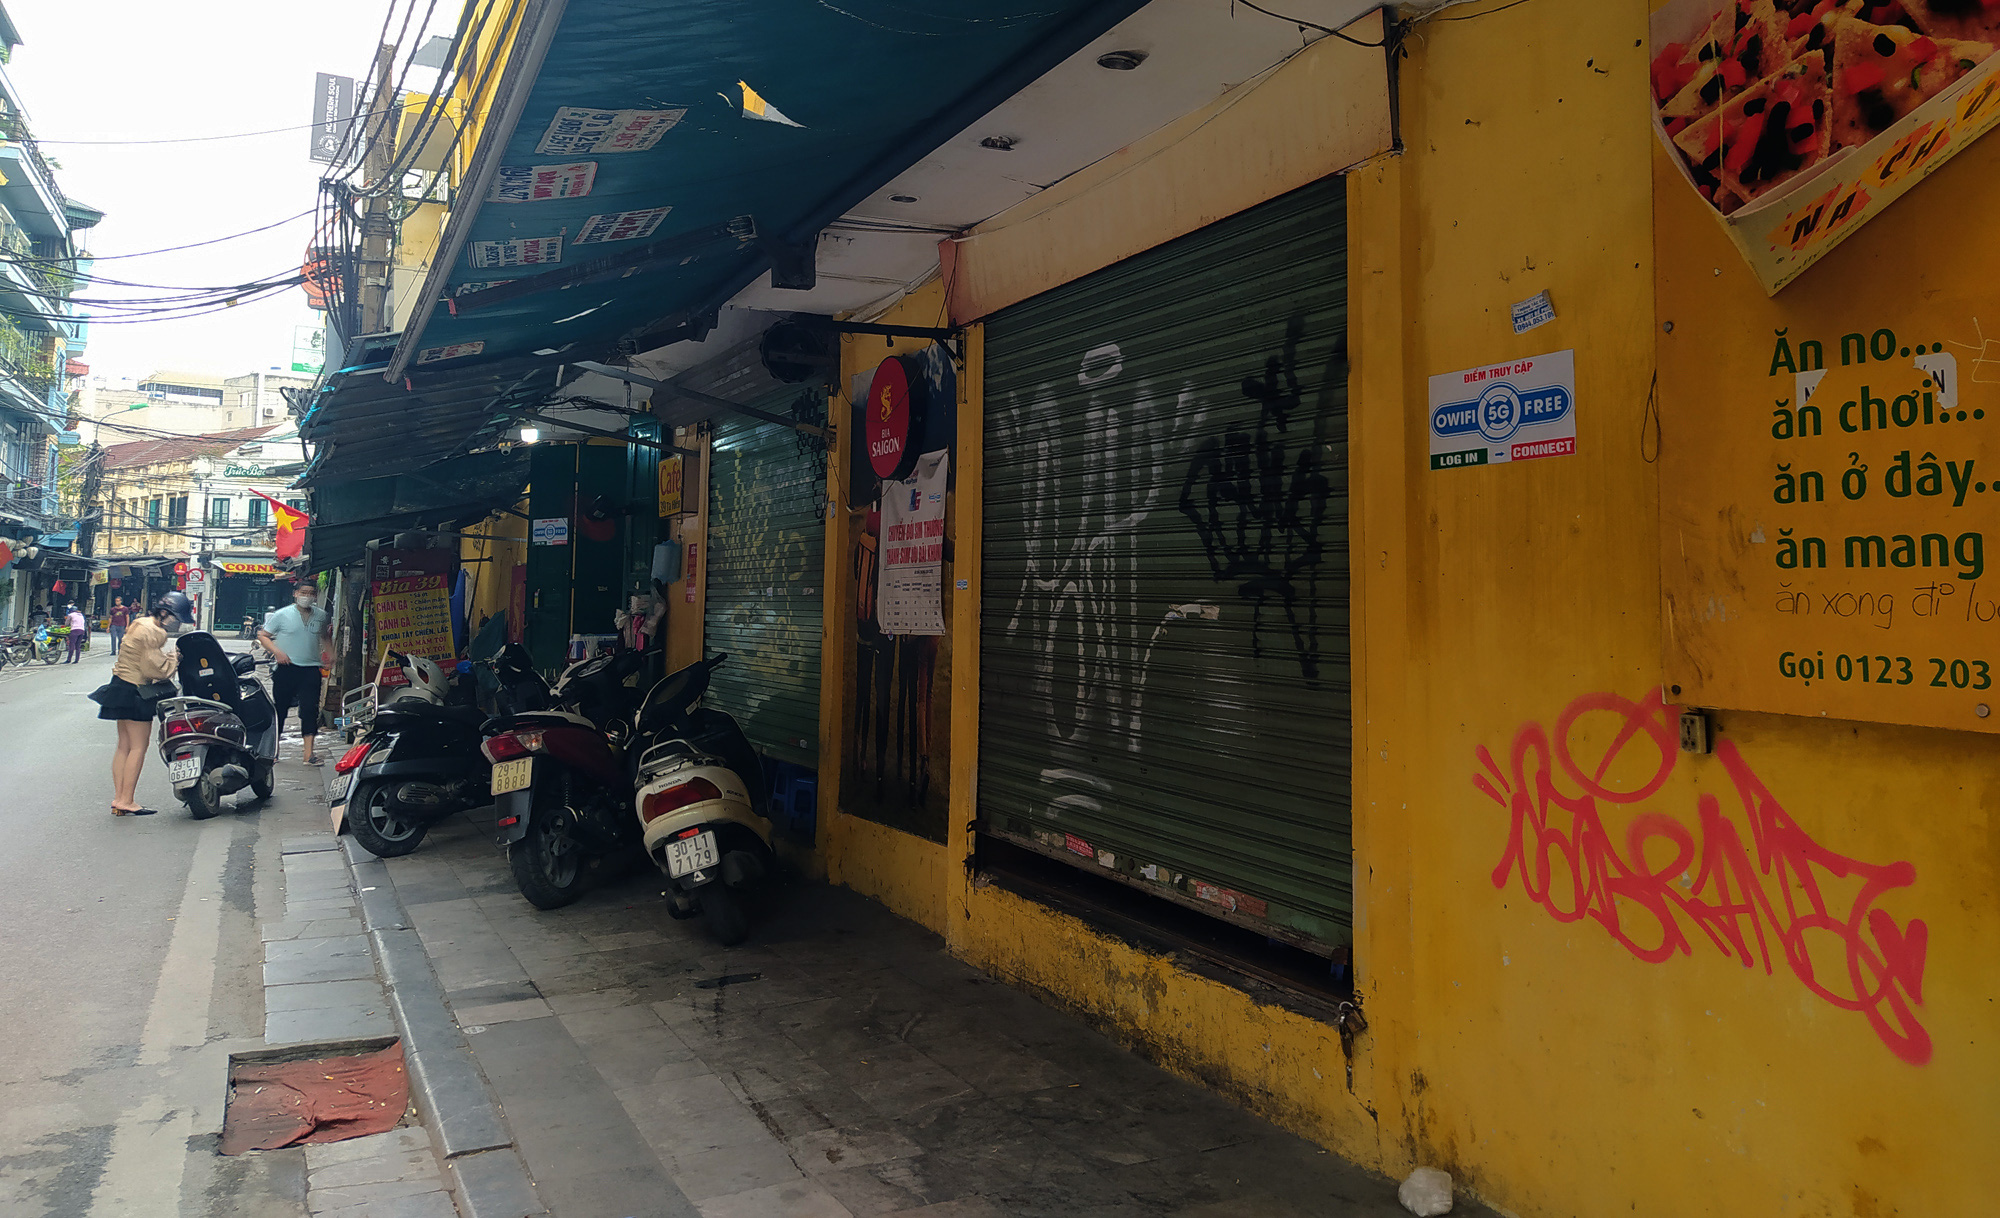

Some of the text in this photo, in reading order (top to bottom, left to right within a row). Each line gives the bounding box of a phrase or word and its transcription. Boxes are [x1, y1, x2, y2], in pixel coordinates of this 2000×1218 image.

[327, 76, 337, 96] SOUL
[325, 96, 336, 133] NORTHERN
[1768, 327, 1943, 377] Ăn no...
[1464, 361, 1533, 383] ĐIỂM TRUY CẬP
[1488, 404, 1510, 421] 5G
[1524, 395, 1562, 415] FREE
[1771, 398, 1822, 439] ăn
[1839, 378, 1985, 433] chơi...
[1435, 409, 1476, 429] OWIFI
[881, 427, 891, 439] BIA
[872, 437, 901, 457] SAIGON
[1513, 440, 1573, 458] CONNECT
[1440, 452, 1478, 466] LOG IN
[1773, 463, 1824, 504] ăn
[1841, 452, 1868, 500] ở
[1775, 527, 1984, 580] ăn mang
[226, 563, 283, 573] CORNE
[378, 575, 441, 595] Bia 39
[376, 599, 397, 613] CHÂN
[1775, 582, 1811, 616] ăn
[1821, 591, 1894, 630] xong
[1965, 582, 2000, 622] lu
[378, 614, 411, 631] CÁNH GÀ
[1778, 651, 1992, 690] Gọi 0123 203
[170, 767, 199, 781] 063.77
[173, 759, 196, 771] 29-C1
[497, 761, 527, 778] 29-T1
[497, 774, 526, 792] 8888
[658, 778, 682, 789] HONDA
[673, 834, 709, 859] 30-L1
[675, 850, 712, 875] 7129
